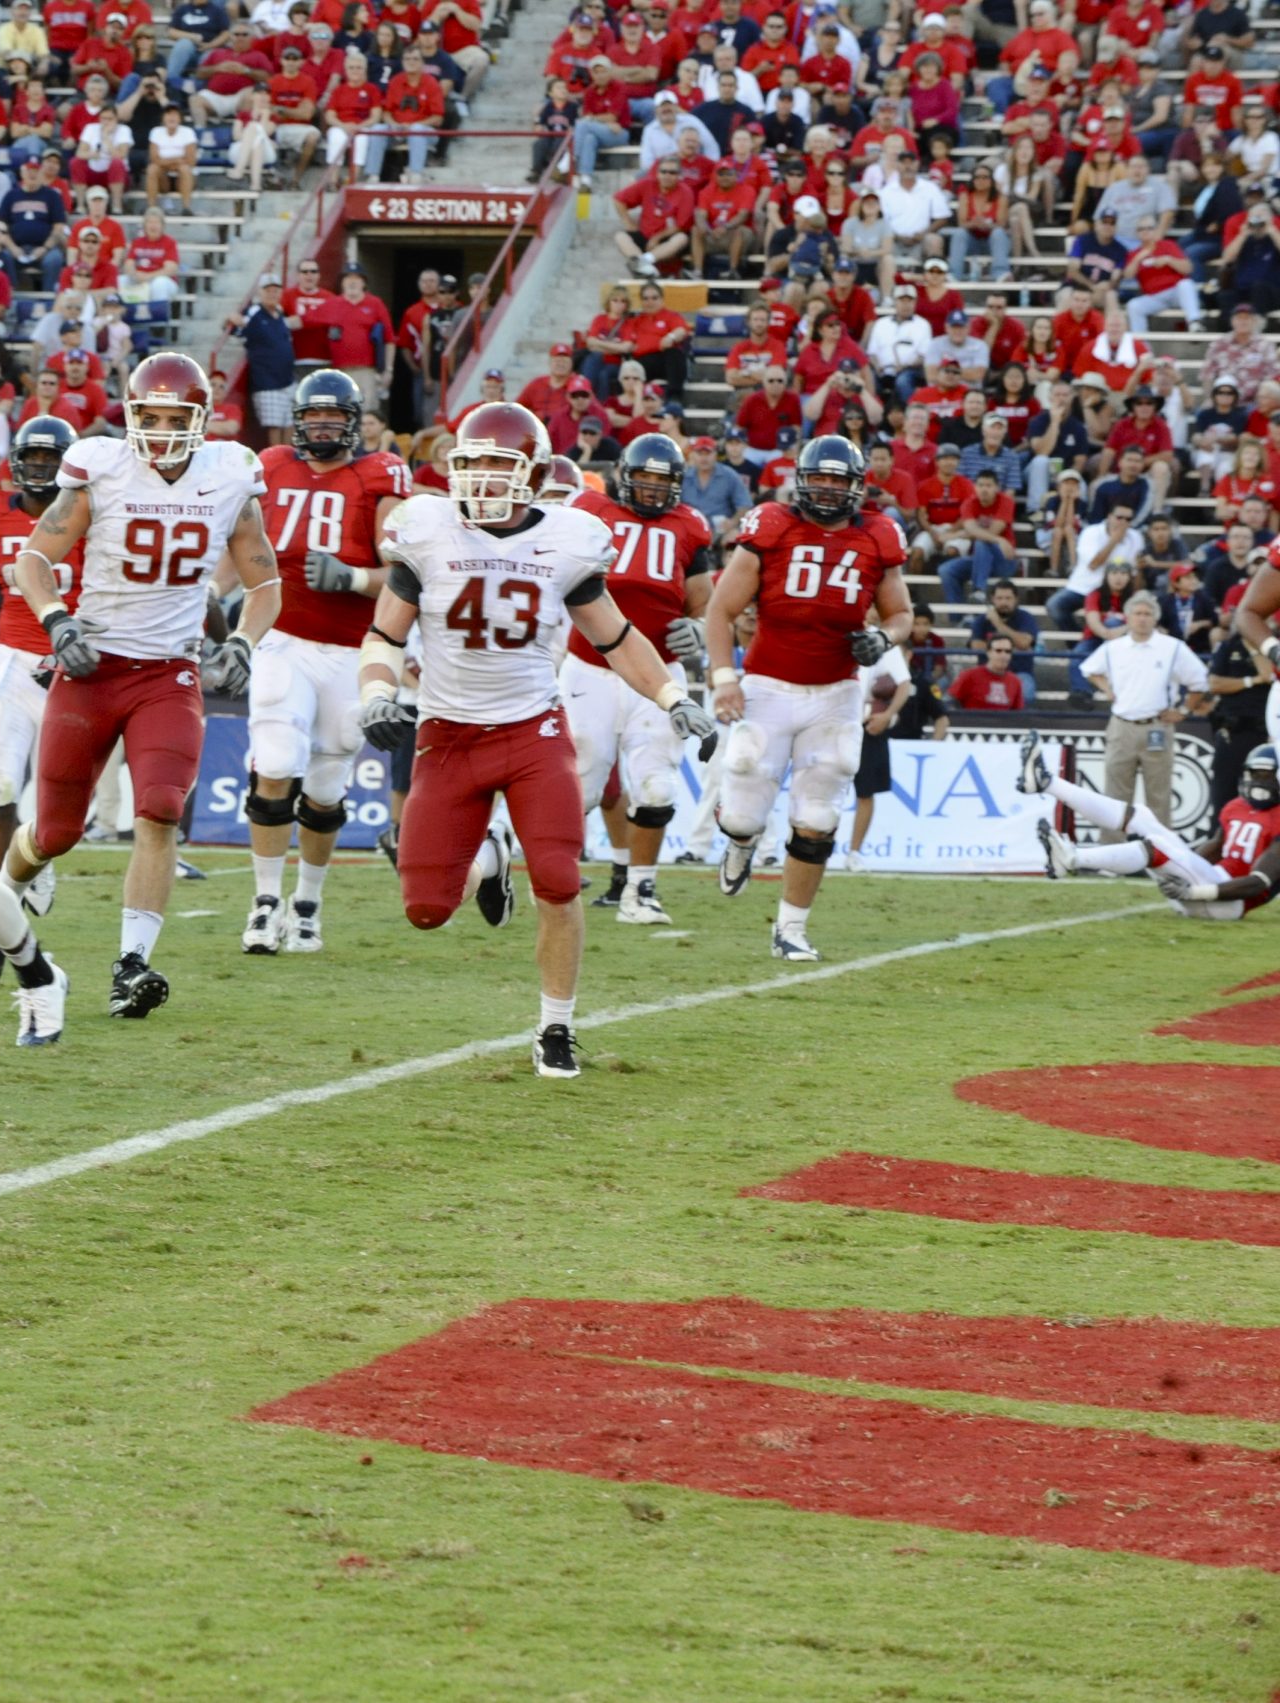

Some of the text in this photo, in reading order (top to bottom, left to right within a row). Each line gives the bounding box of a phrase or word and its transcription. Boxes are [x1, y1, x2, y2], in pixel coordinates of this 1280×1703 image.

[387, 198, 507, 222] 23 SECTION 24
[125, 503, 215, 517] WASHINGTON STATE
[275, 487, 346, 554] 78
[122, 518, 210, 587] 92
[446, 558, 555, 579] WASHINGTON STATE
[613, 520, 676, 582] 70
[784, 544, 863, 605] 64
[445, 576, 543, 650] 43
[905, 836, 925, 858] it
[936, 842, 1008, 858] most
[1221, 819, 1263, 865] 19
